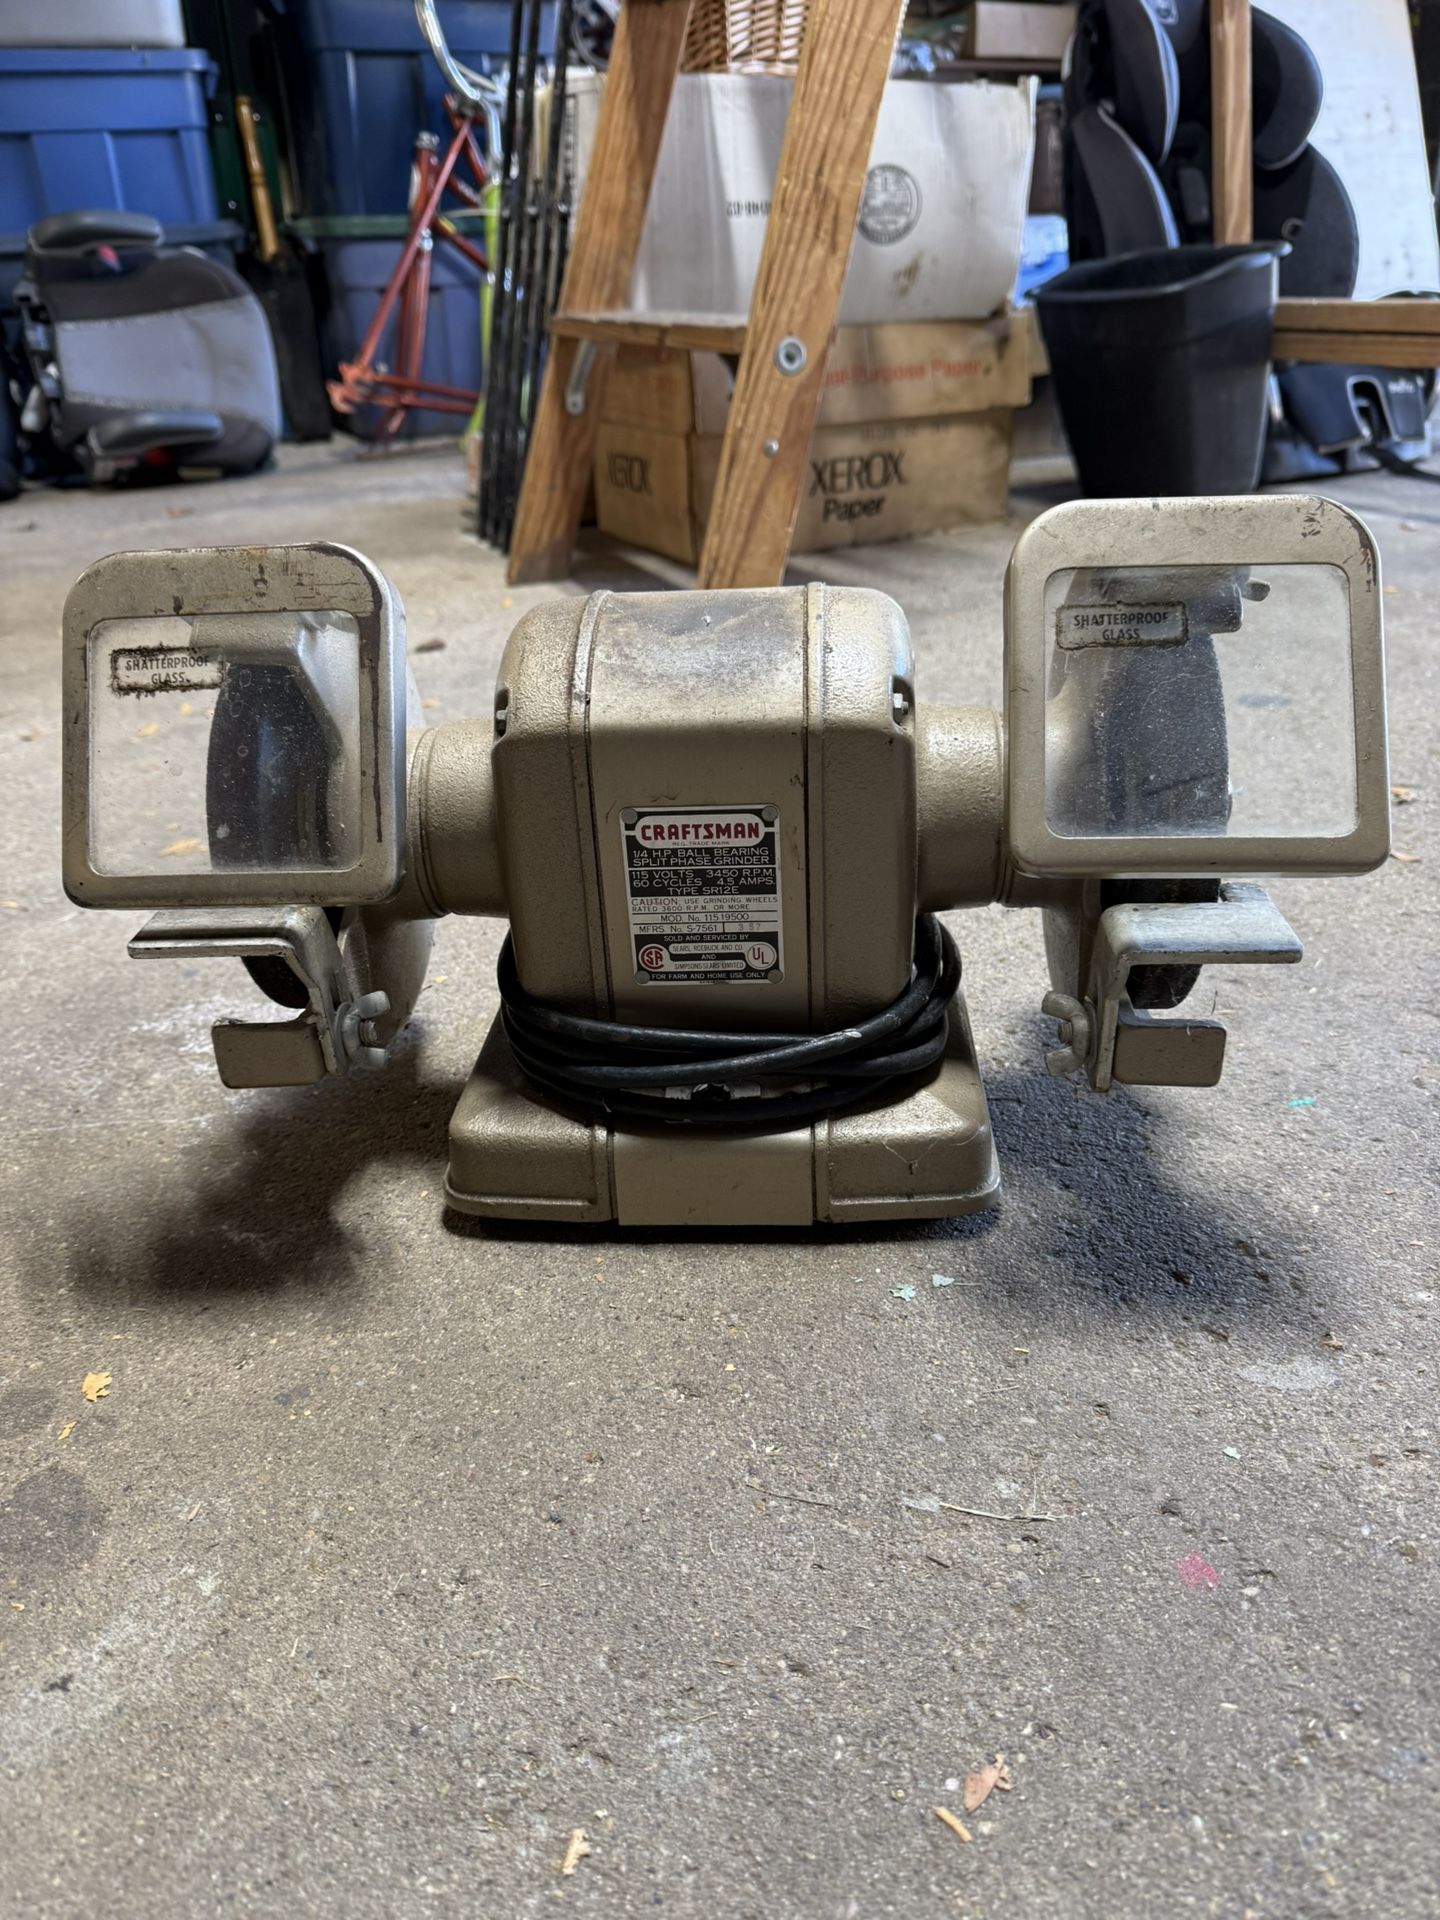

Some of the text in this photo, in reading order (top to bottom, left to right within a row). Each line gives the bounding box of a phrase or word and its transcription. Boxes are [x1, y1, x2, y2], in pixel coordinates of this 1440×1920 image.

[808, 450, 908, 497] XEROX
[823, 493, 886, 524] Paper
[1073, 611, 1169, 627] SHATTERPROOF
[1102, 628, 1140, 641] GLASS
[125, 655, 211, 672] SHATTERPROOF
[641, 822, 760, 841] CRAFTSMAN
[633, 846, 769, 858] 1/4 H.P. BALL BEARING
[633, 855, 769, 867] SPLIT PHASE GRINDER
[632, 867, 775, 879] 115 VOLTS 3450 R.P.M.
[633, 876, 775, 888] 60 CYCLES 4.5 AMPS.
[667, 885, 740, 895] TYPE SR12E
[686, 924, 717, 933] S-7561
[752, 947, 770, 964] UL
